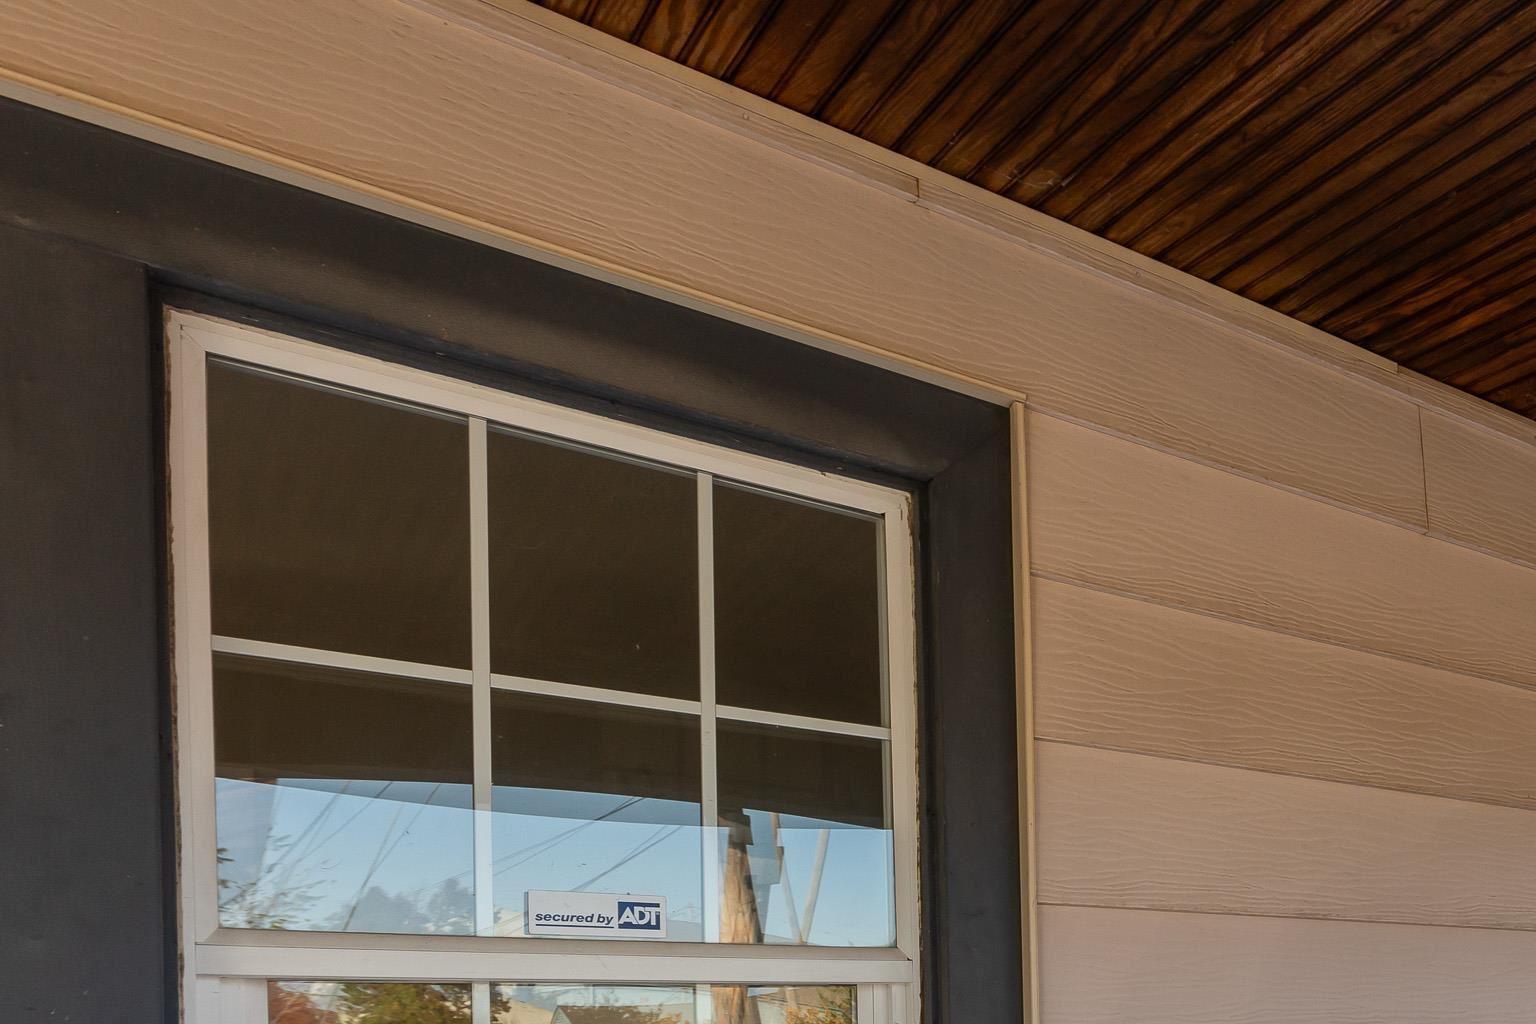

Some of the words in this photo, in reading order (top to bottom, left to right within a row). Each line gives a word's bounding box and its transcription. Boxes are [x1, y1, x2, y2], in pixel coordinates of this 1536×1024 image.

[535, 912, 593, 923] secured
[596, 914, 614, 925] by
[618, 906, 661, 926] ADT
